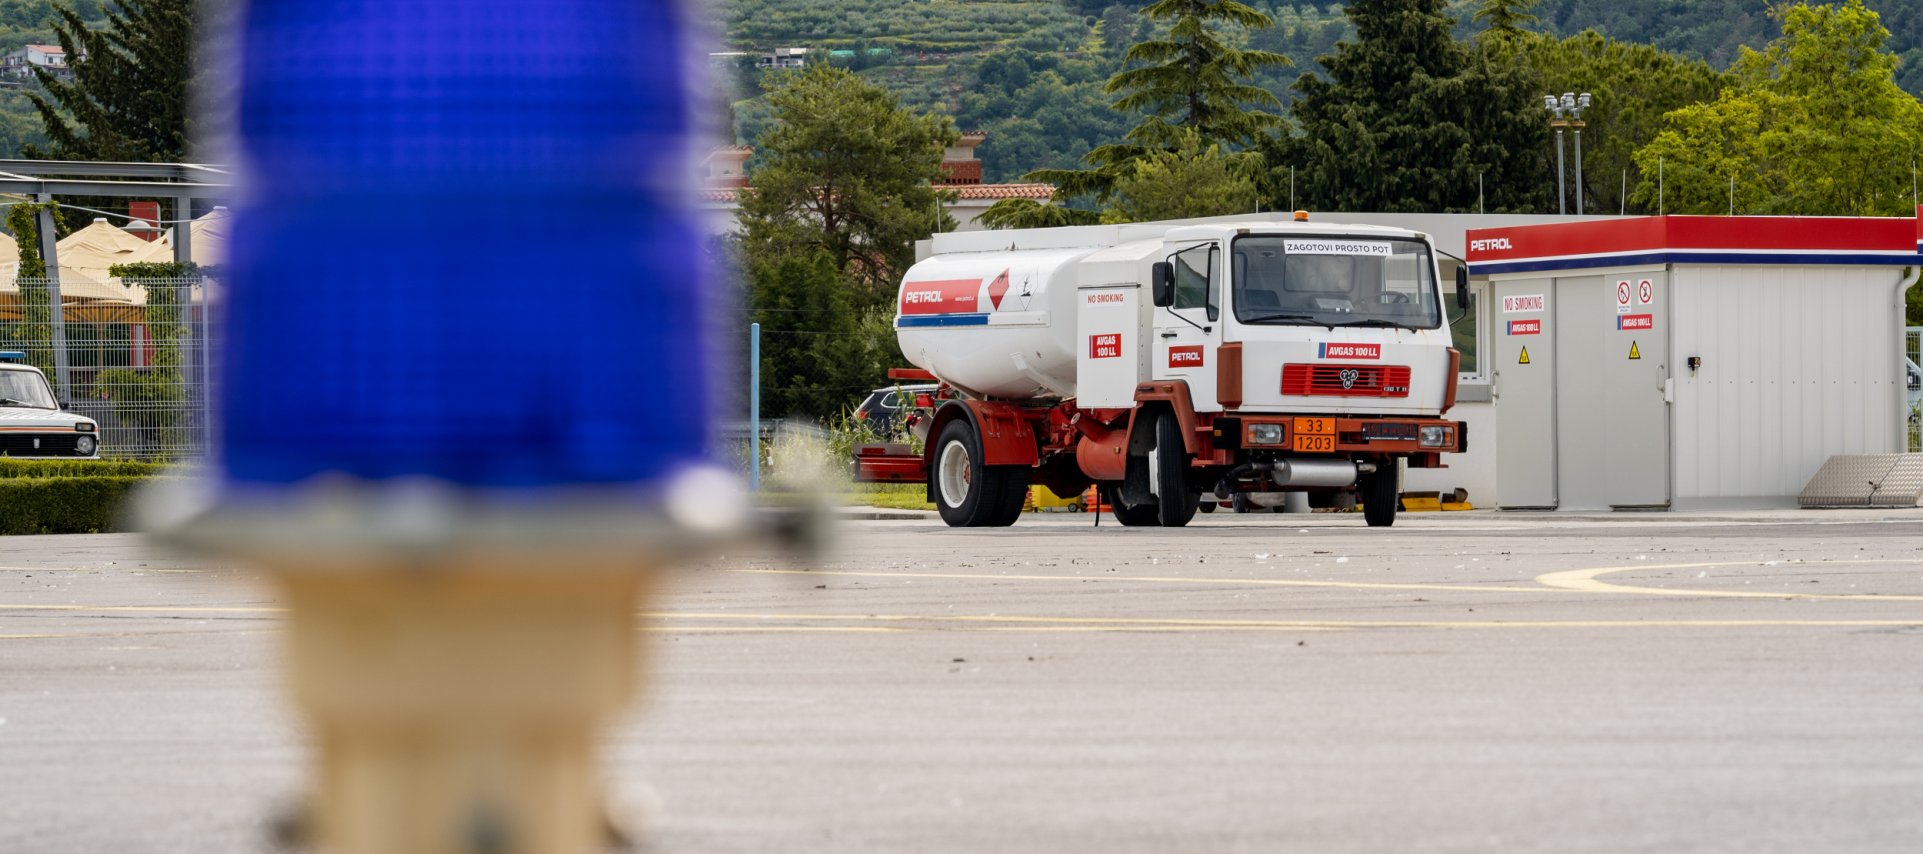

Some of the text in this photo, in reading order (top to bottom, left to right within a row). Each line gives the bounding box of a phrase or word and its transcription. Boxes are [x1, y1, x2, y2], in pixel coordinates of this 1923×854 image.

[1287, 243, 1389, 253] ZAGOTOVI PROSTO POT
[1471, 238, 1512, 251] PETROL
[905, 290, 943, 304] PETROL
[1087, 293, 1124, 303] NO SMOKING
[1504, 296, 1542, 311] NO SMOKING
[1096, 335, 1116, 345] AVGAS
[1097, 346, 1116, 357] 100 LL
[1171, 352, 1201, 361] PETROL
[1328, 346, 1354, 356] AVGAS
[1306, 419, 1323, 432] 33
[1298, 436, 1331, 450] 1203
